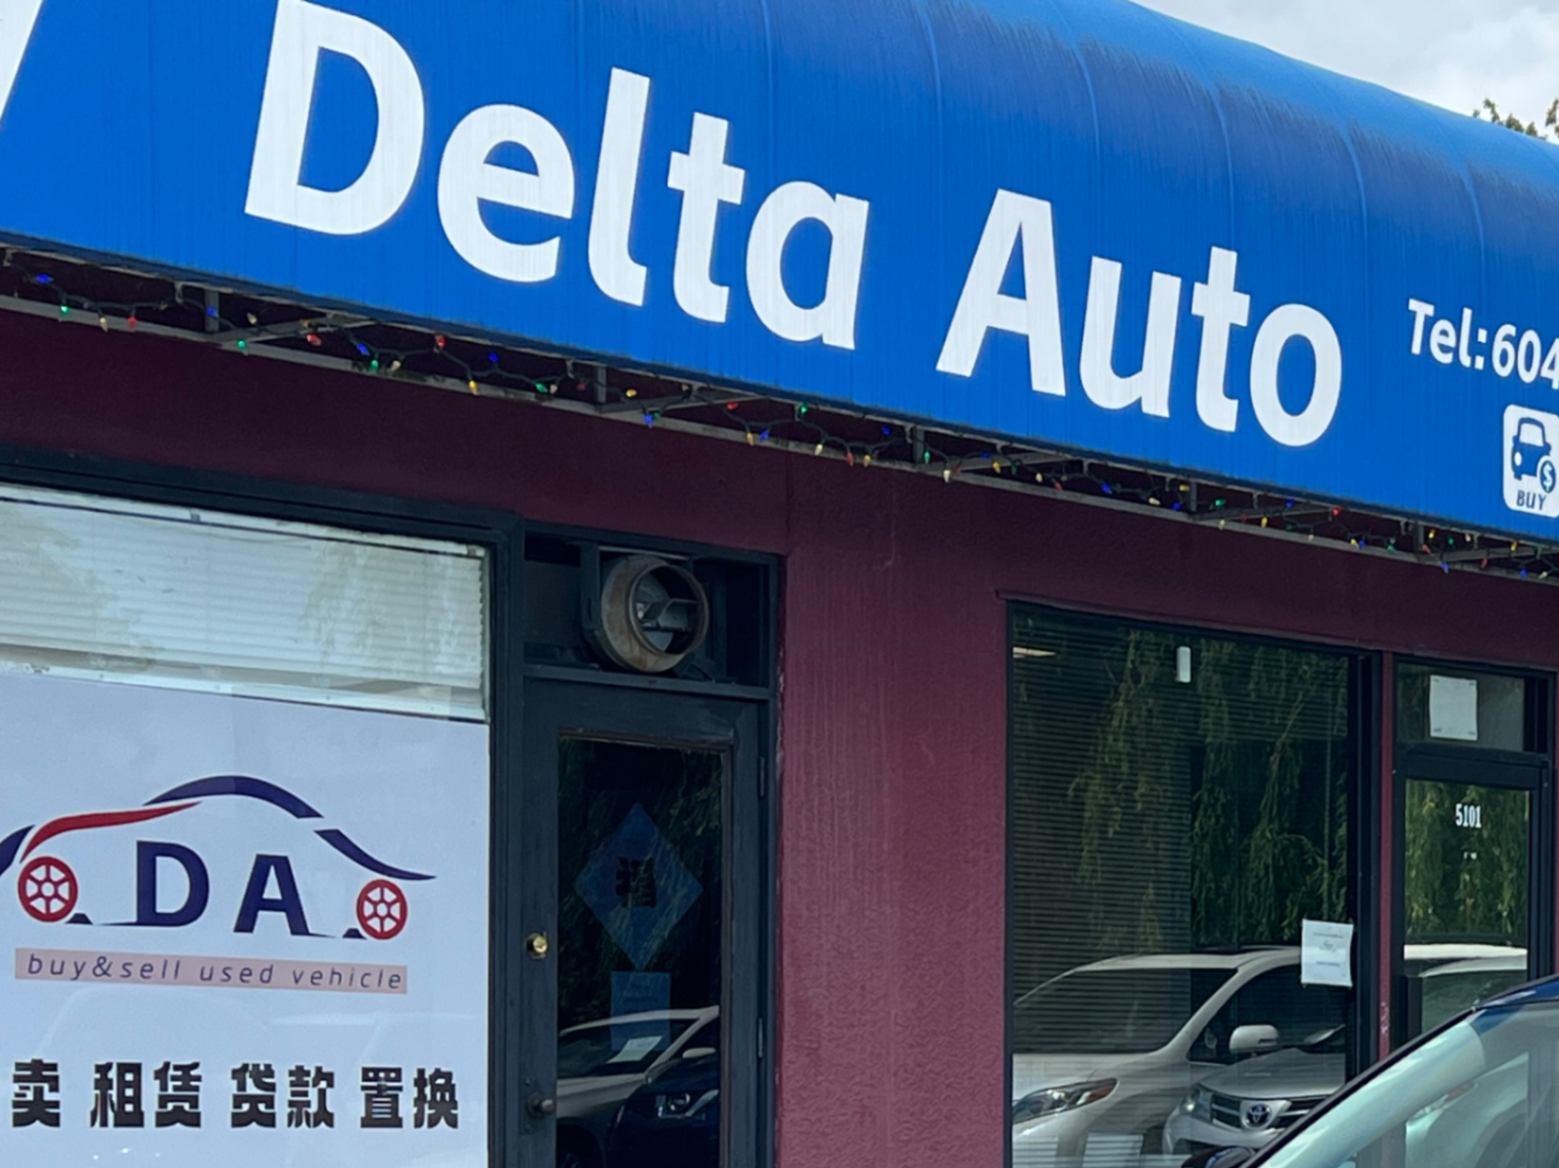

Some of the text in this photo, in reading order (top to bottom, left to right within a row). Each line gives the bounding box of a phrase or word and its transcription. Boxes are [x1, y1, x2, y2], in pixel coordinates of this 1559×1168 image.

[244, 0, 1342, 447] Delta Auto
[1516, 489, 1546, 511] BUY
[27, 953, 402, 990] buy&sell used vehicle
[12, 1059, 458, 1128] 卖 租赁 贷款 置换
